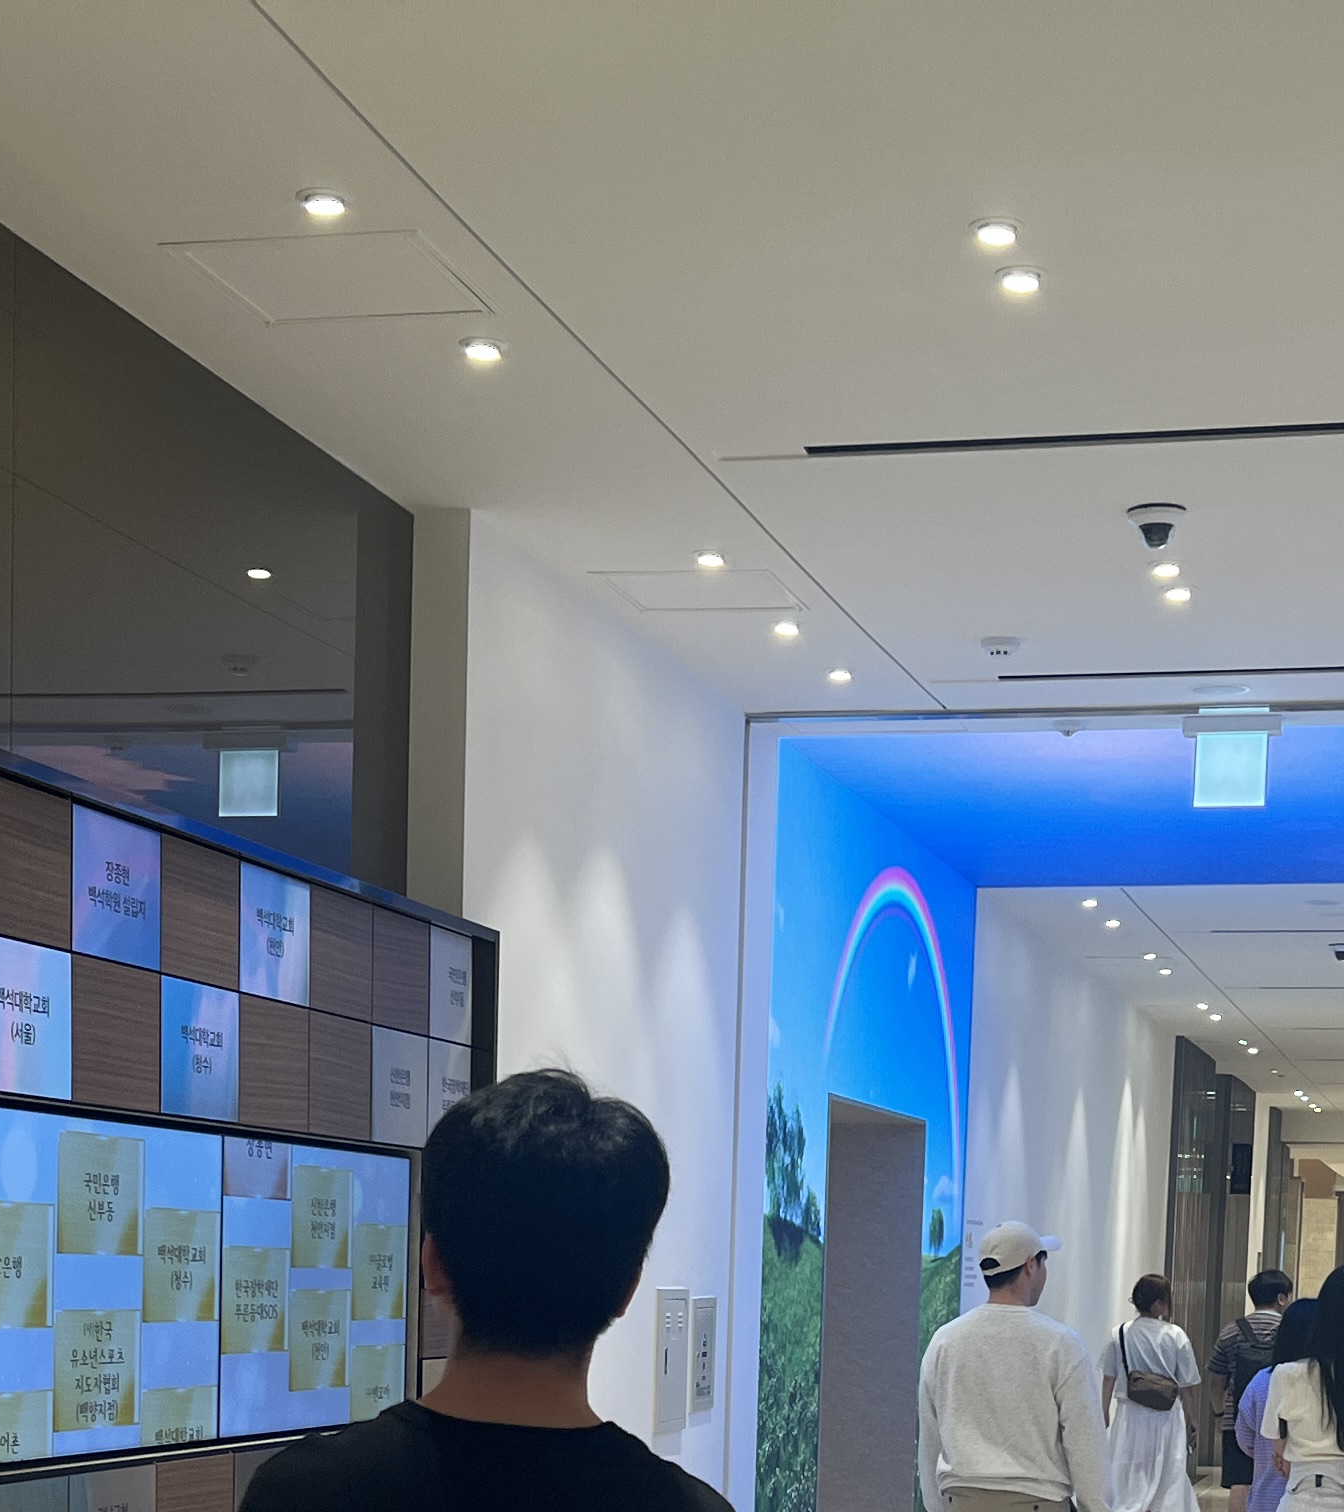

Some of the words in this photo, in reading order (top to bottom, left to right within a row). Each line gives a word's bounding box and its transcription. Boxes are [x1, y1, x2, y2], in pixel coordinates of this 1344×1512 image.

[105, 860, 130, 887] 장종현
[87, 886, 122, 917] 백석학원
[10, 1020, 37, 1046] (서울)
[180, 1024, 224, 1049] 백석대학교회
[83, 1172, 121, 1197] 국민은행
[87, 1201, 115, 1223] 신부동
[157, 1244, 207, 1266] 백석대학교회
[69, 1347, 126, 1370] 유소년스포츠
[74, 1372, 121, 1396] 지도자협회
